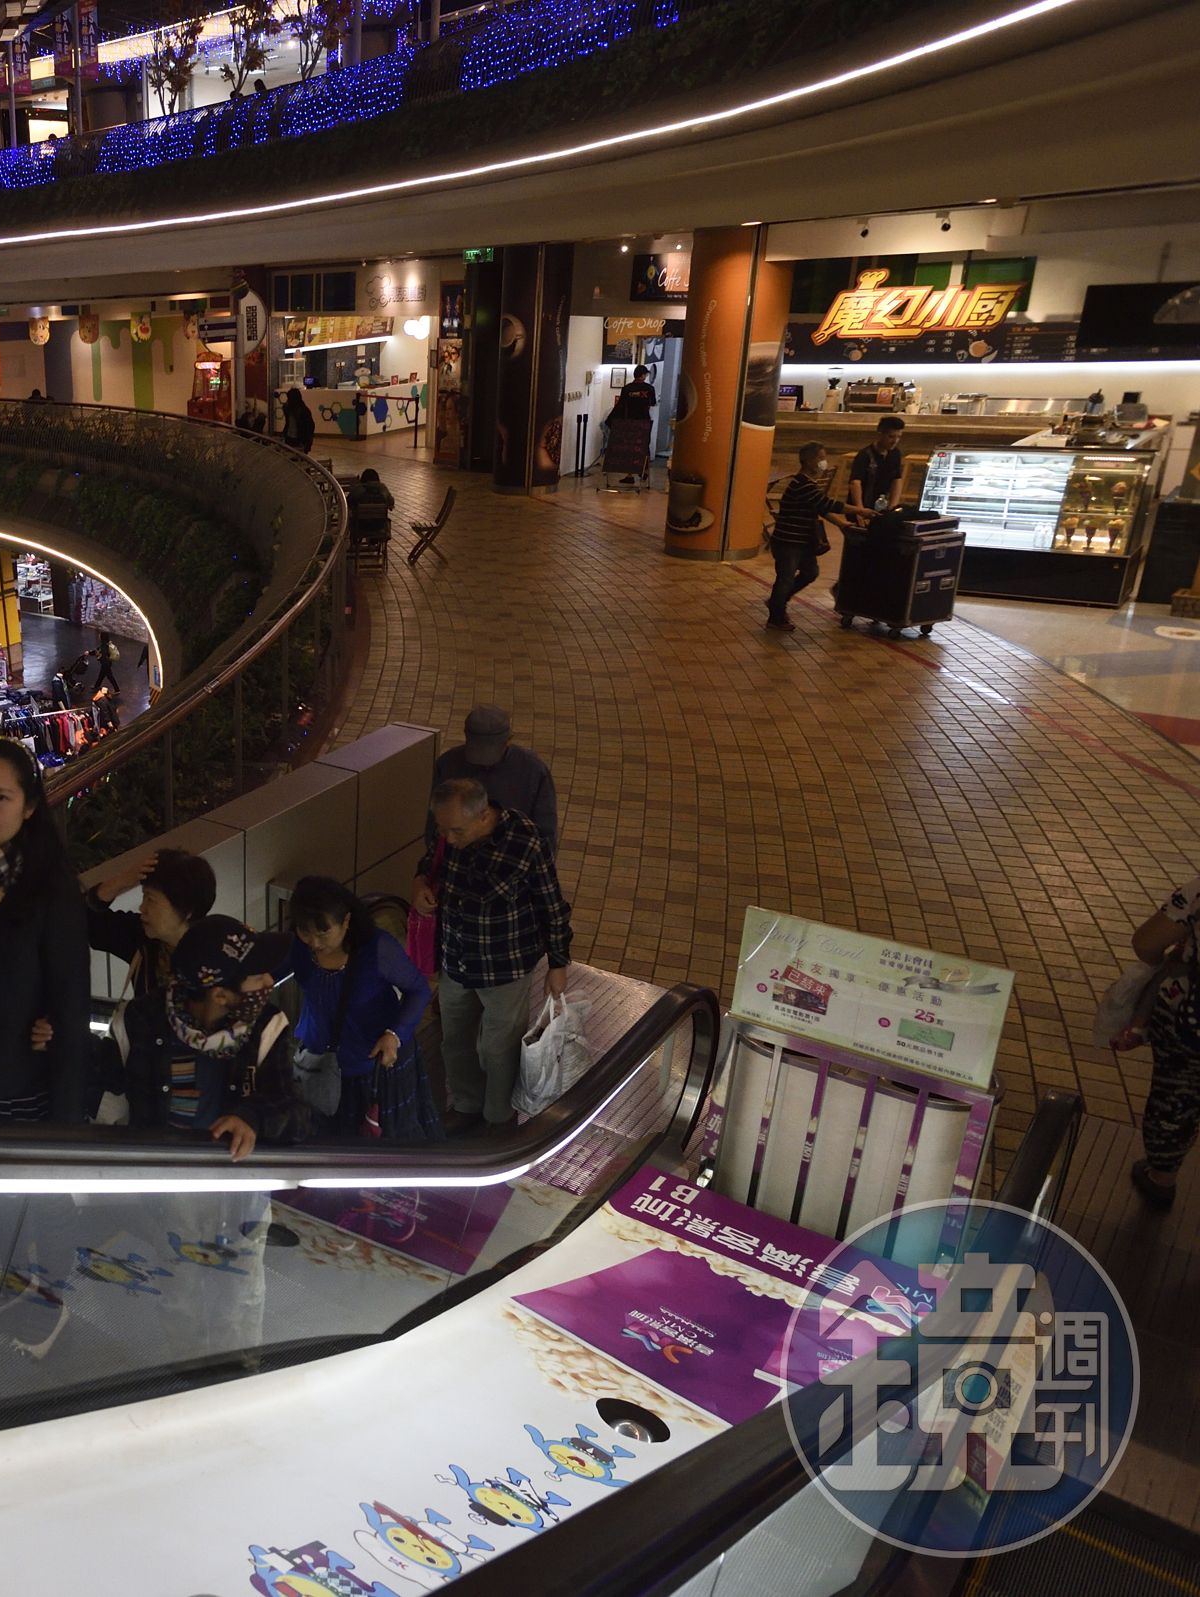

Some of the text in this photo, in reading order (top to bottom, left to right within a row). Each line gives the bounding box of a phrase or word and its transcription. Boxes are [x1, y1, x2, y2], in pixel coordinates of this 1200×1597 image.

[637, 317, 667, 332] Shop
[630, 1192, 861, 1298] 喜滿客影城
